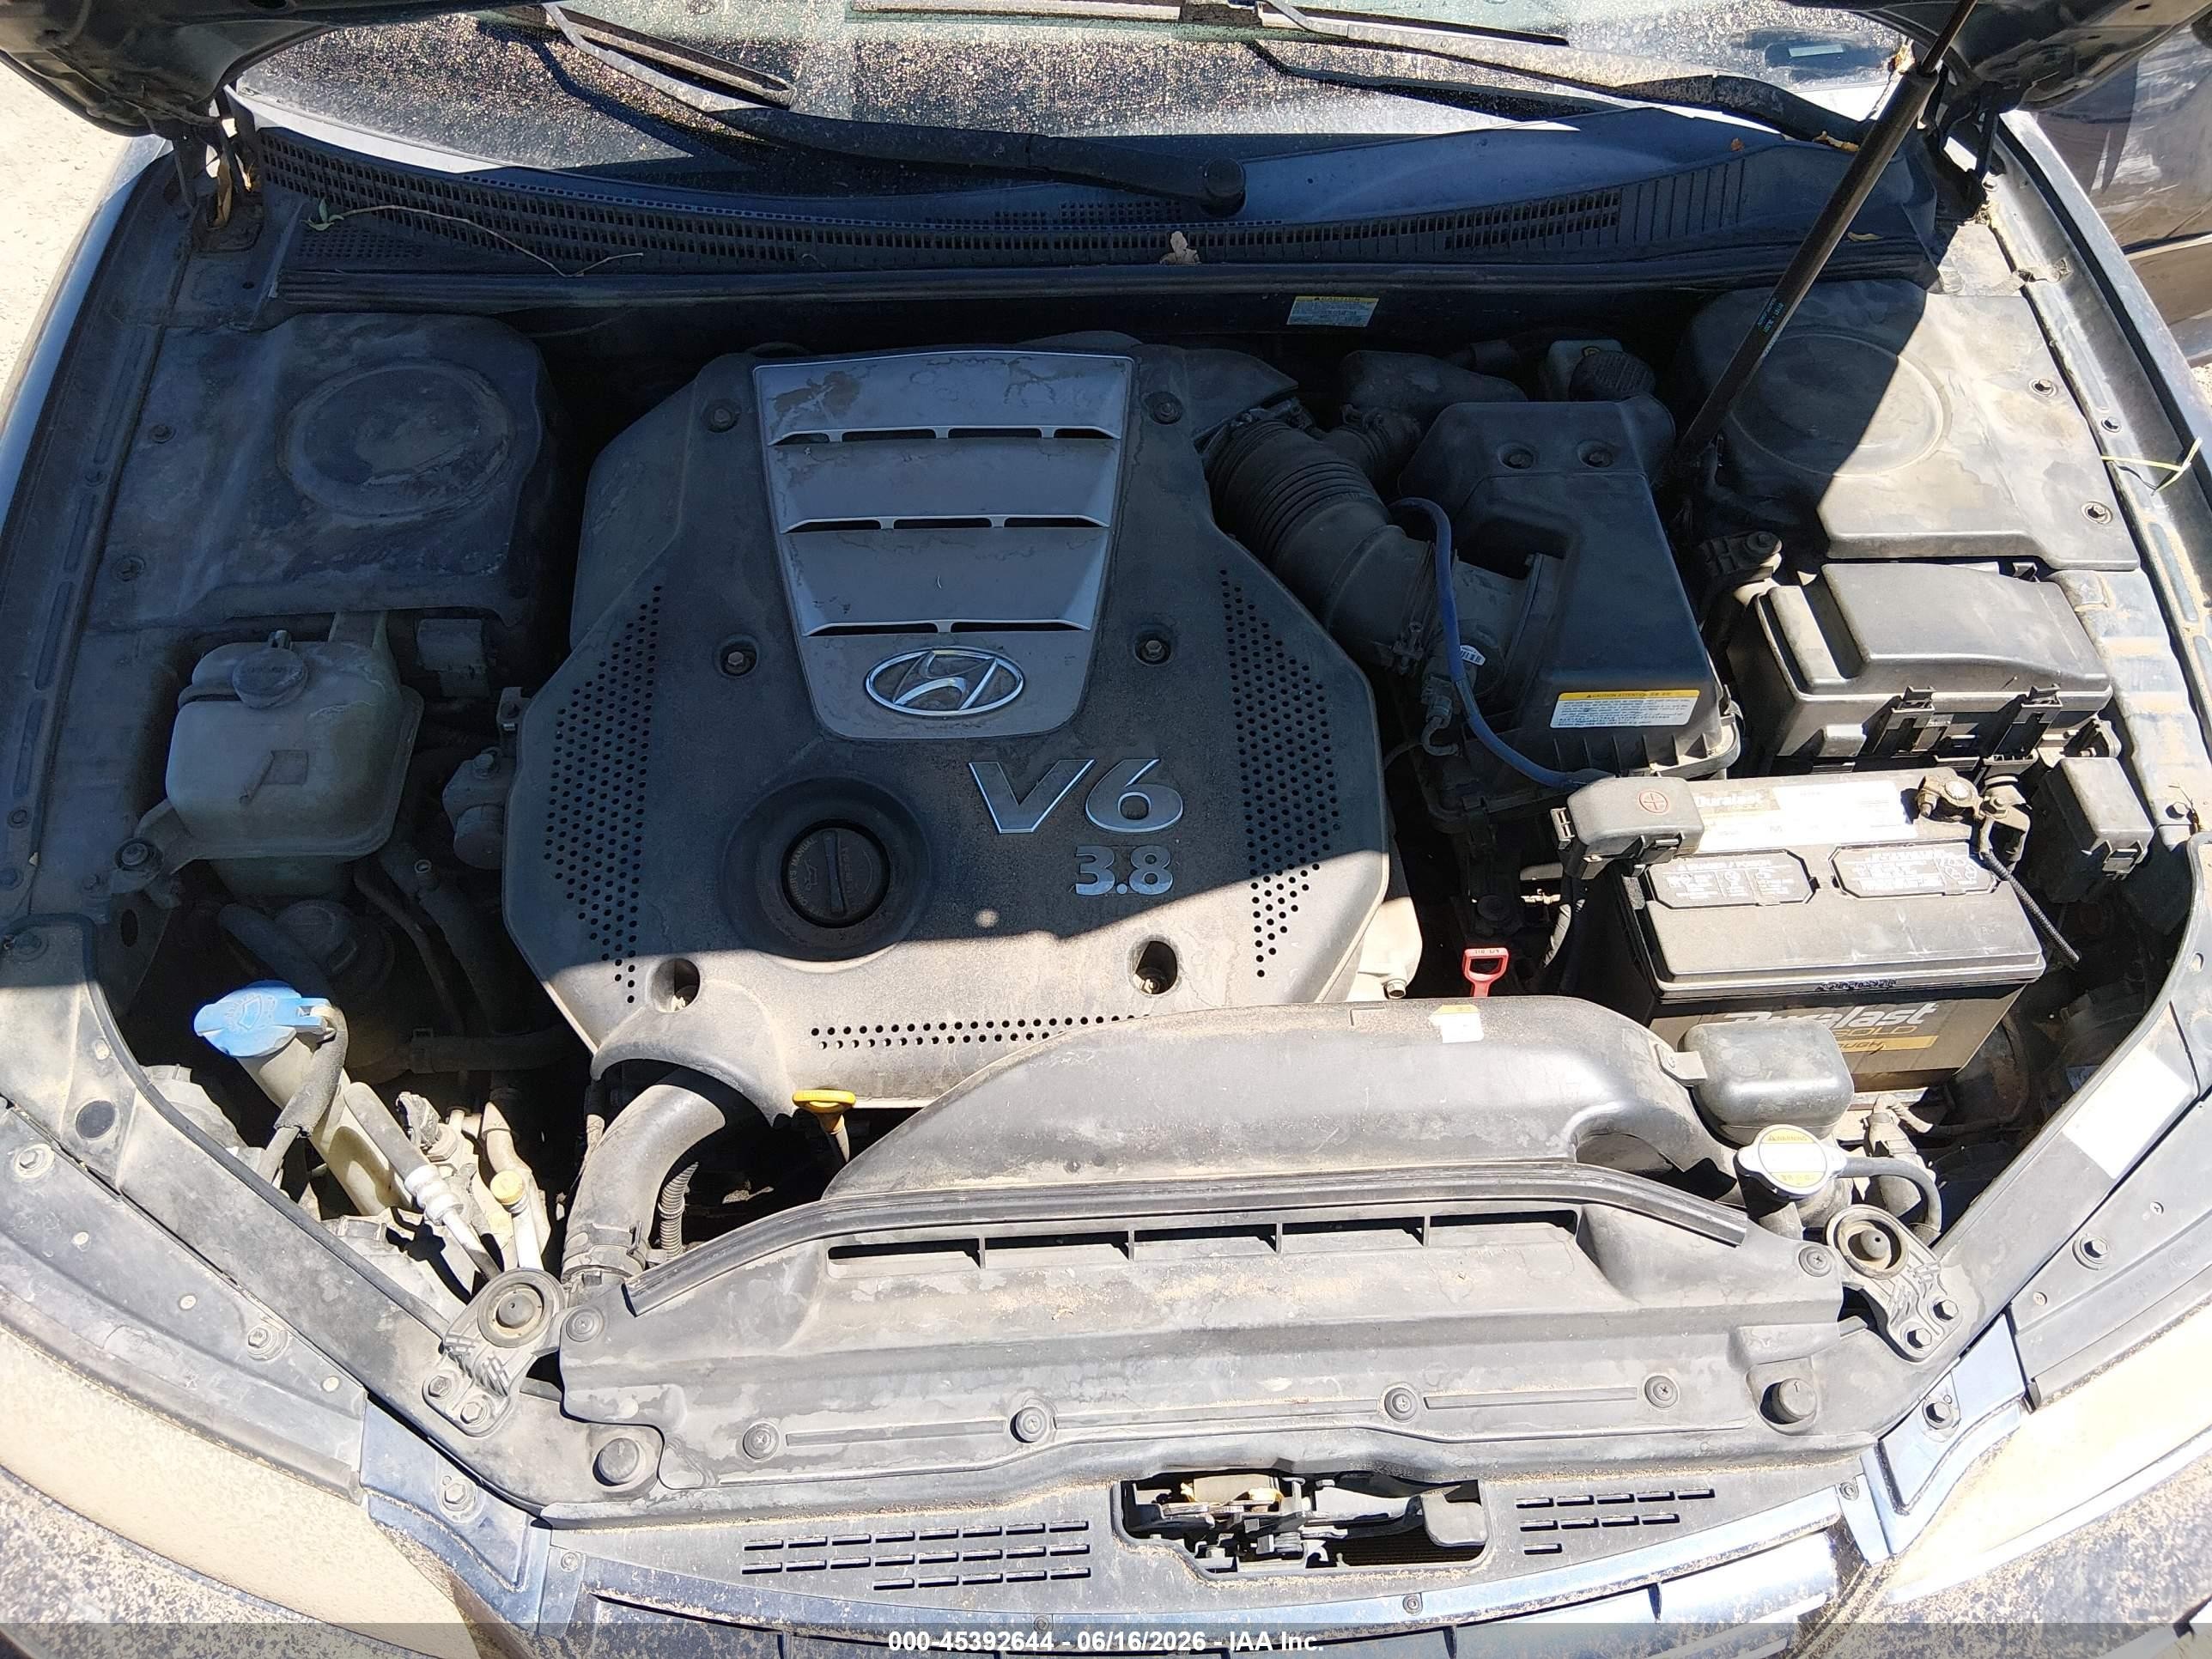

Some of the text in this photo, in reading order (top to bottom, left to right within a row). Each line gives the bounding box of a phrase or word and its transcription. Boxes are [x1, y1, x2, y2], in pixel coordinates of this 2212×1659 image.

[968, 758, 1184, 834] V6
[1074, 845, 1174, 896] 3.8
[1838, 1040, 1883, 1048] UGH
